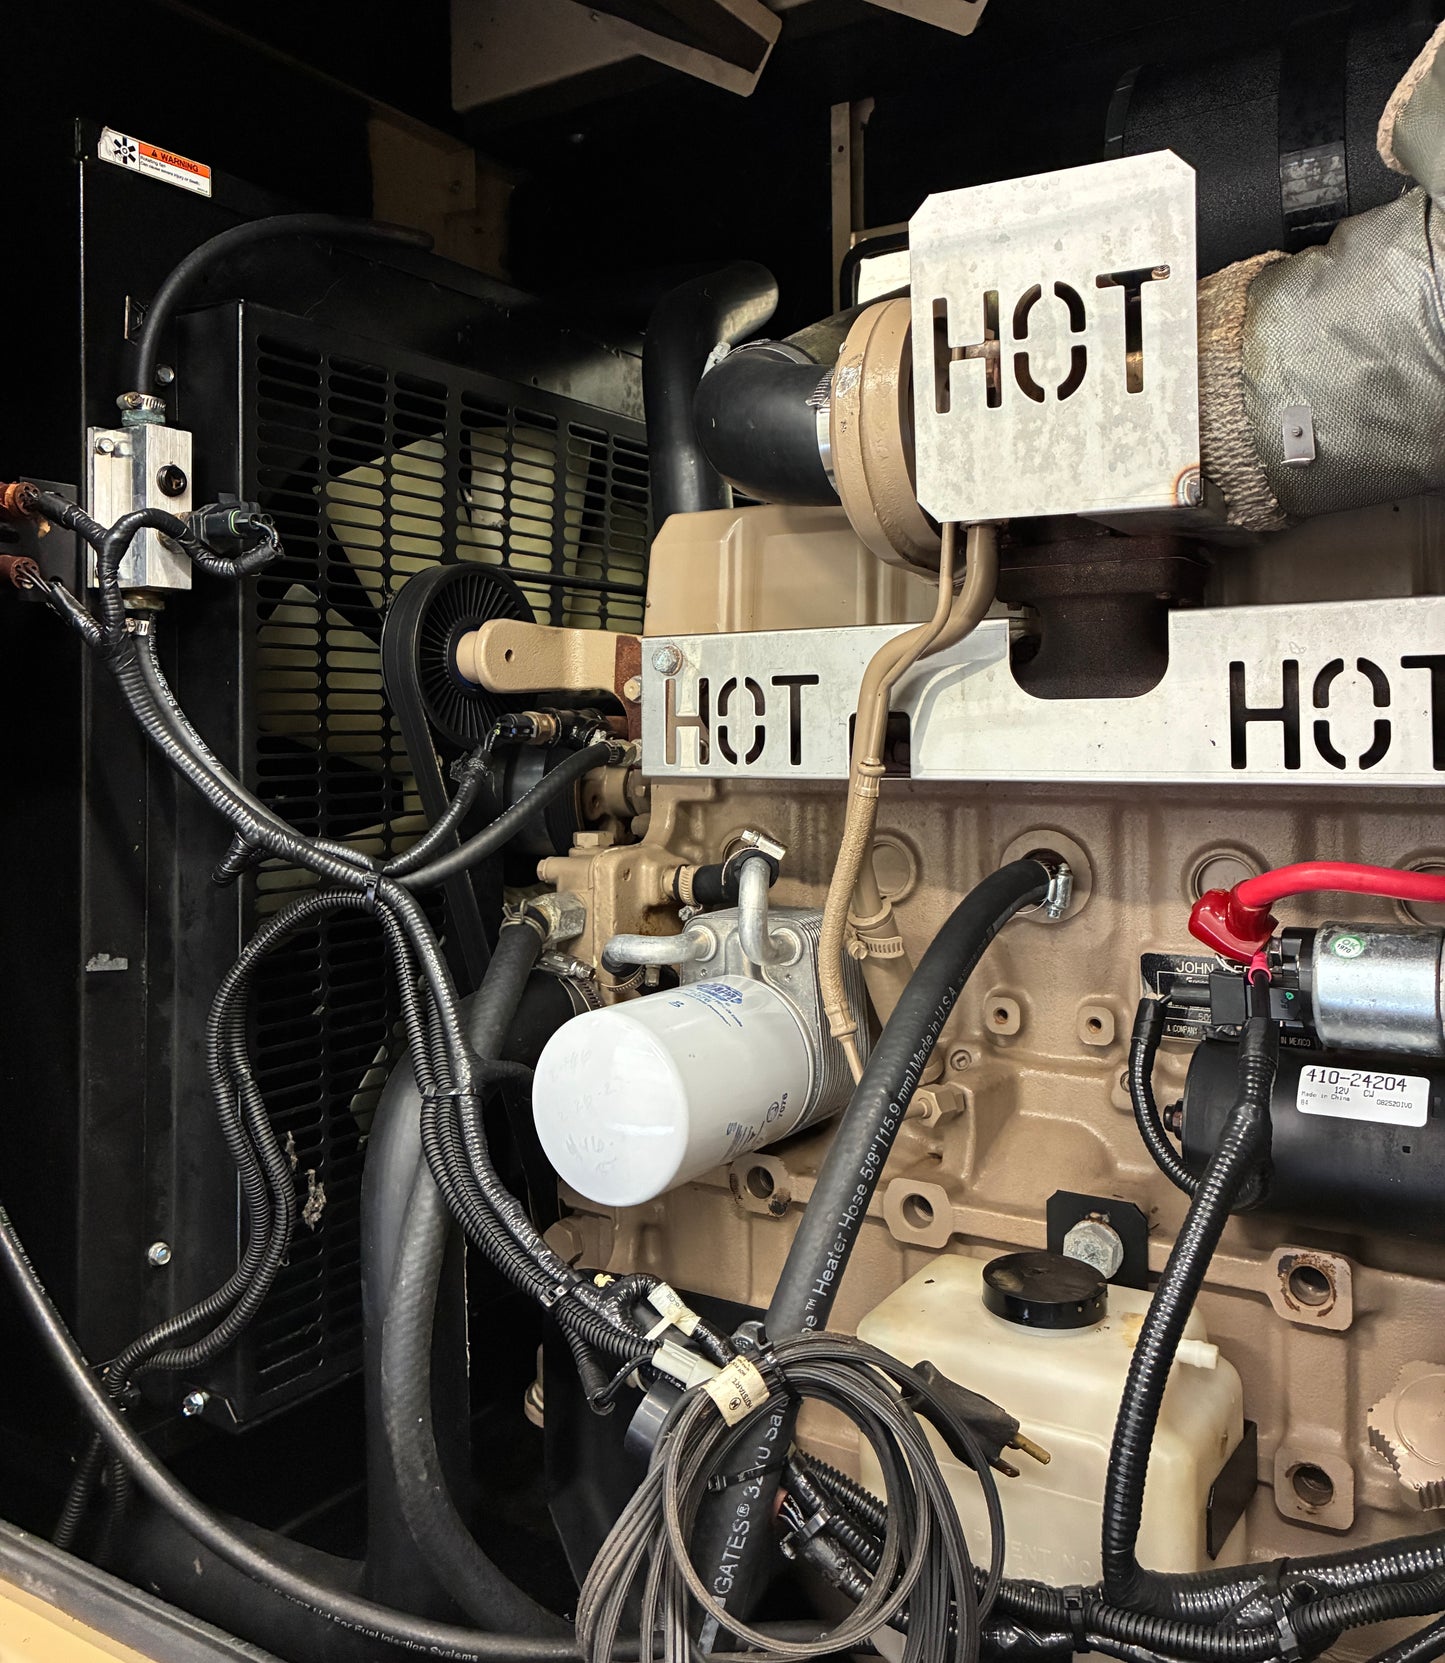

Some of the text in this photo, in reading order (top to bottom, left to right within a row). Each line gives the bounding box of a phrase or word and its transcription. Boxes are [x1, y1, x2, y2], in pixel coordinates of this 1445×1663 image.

[161, 153, 198, 172] WARNING
[932, 264, 1170, 414] HOT
[665, 674, 820, 766] HOT
[1229, 654, 1445, 771] HOT
[1342, 939, 1358, 950] OK
[1176, 961, 1214, 974] JOHN
[1173, 1025, 1199, 1036] COMPANY
[1288, 1037, 1311, 1047] MEXICO
[1306, 1069, 1407, 1092] 410-24204
[1331, 1094, 1351, 1102] China
[1335, 1086, 1374, 1098] 12V CW
[812, 1230, 848, 1297] Heater
[838, 1183, 868, 1231] Hose
[860, 1142, 882, 1181] 5/8"
[875, 1102, 900, 1148] [15.9
[897, 1071, 916, 1104] mm]
[912, 1035, 933, 1071] Made
[930, 1022, 941, 1038] in
[333, 1616, 353, 1630] For
[354, 1624, 379, 1641] Fuel
[380, 1632, 428, 1651] Injection
[429, 1646, 479, 1663] Systems
